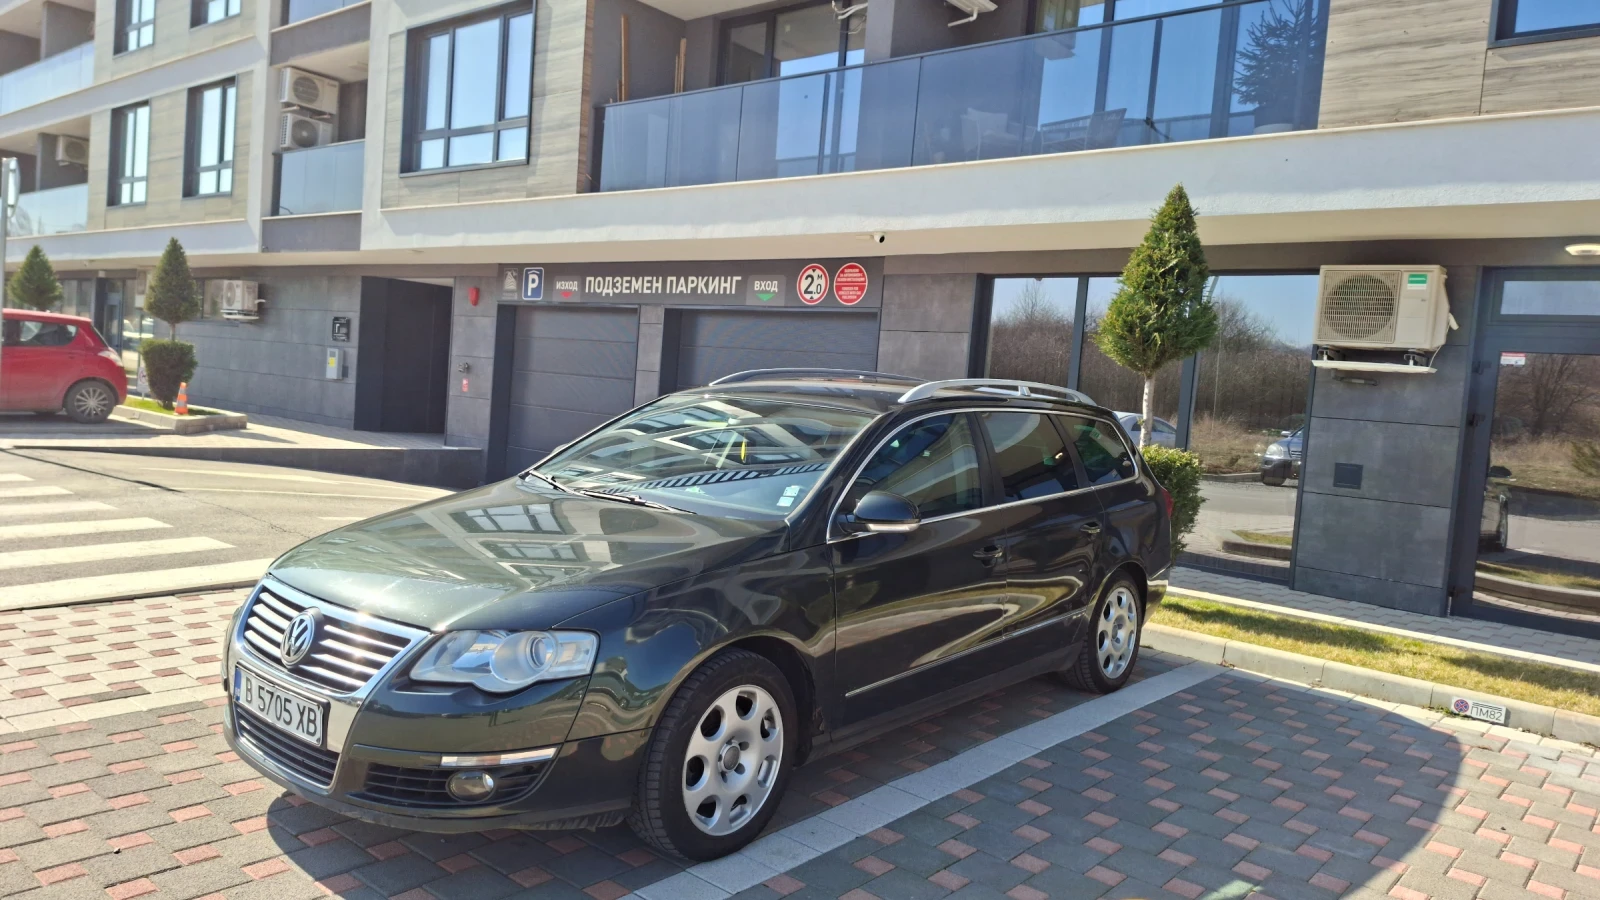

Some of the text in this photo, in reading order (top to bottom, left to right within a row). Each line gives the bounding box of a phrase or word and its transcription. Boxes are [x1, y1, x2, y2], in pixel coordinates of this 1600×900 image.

[527, 274, 539, 297] P
[556, 280, 578, 291] ИЗХОД
[585, 276, 742, 297] ПОДЗЕМЕН ПАРКИНГ
[754, 280, 778, 292] ВХОД
[258, 685, 293, 726] 5705
